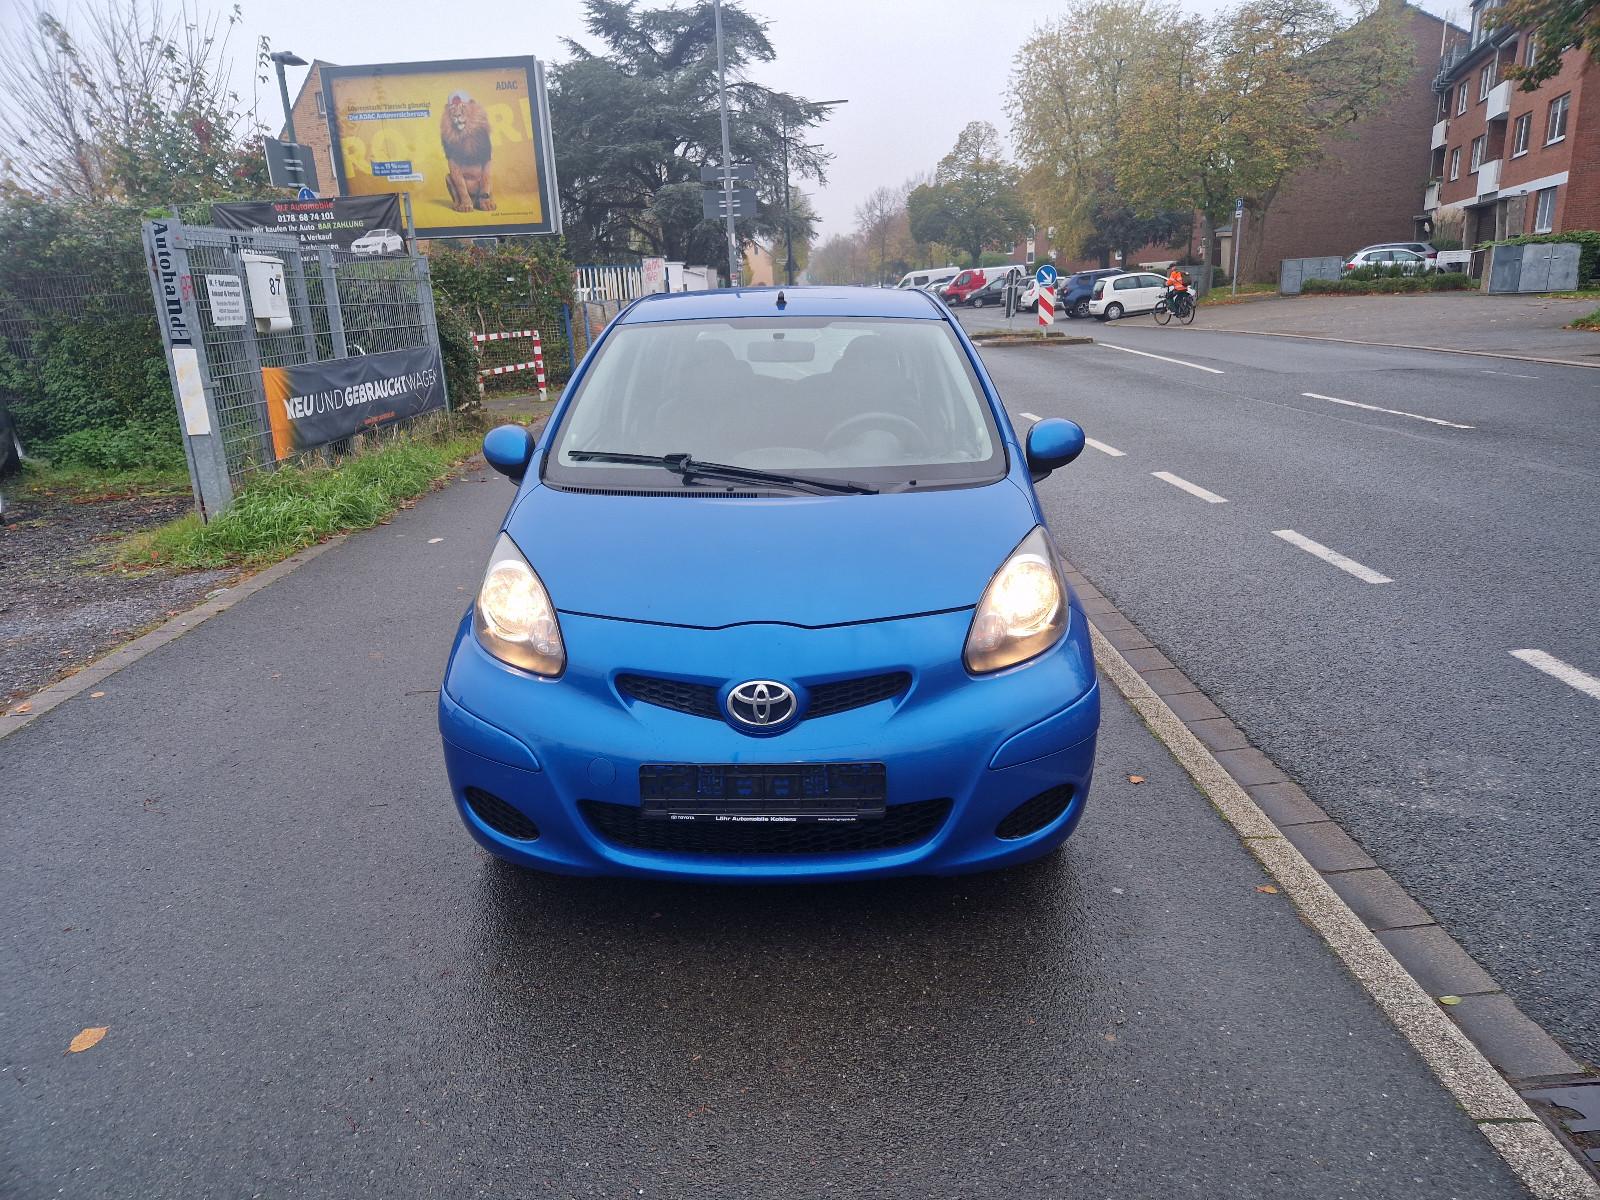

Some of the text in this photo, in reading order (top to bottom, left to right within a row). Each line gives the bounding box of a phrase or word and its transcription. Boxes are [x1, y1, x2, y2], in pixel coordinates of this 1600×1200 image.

[496, 81, 518, 90] ADAC
[291, 202, 334, 211] Automobile
[277, 212, 335, 223] 0178 68 74 101
[265, 225, 287, 233] kaufen
[300, 232, 332, 242] & Verkauf
[269, 278, 281, 296] 87
[283, 394, 314, 420] NEU
[315, 389, 344, 413] UND
